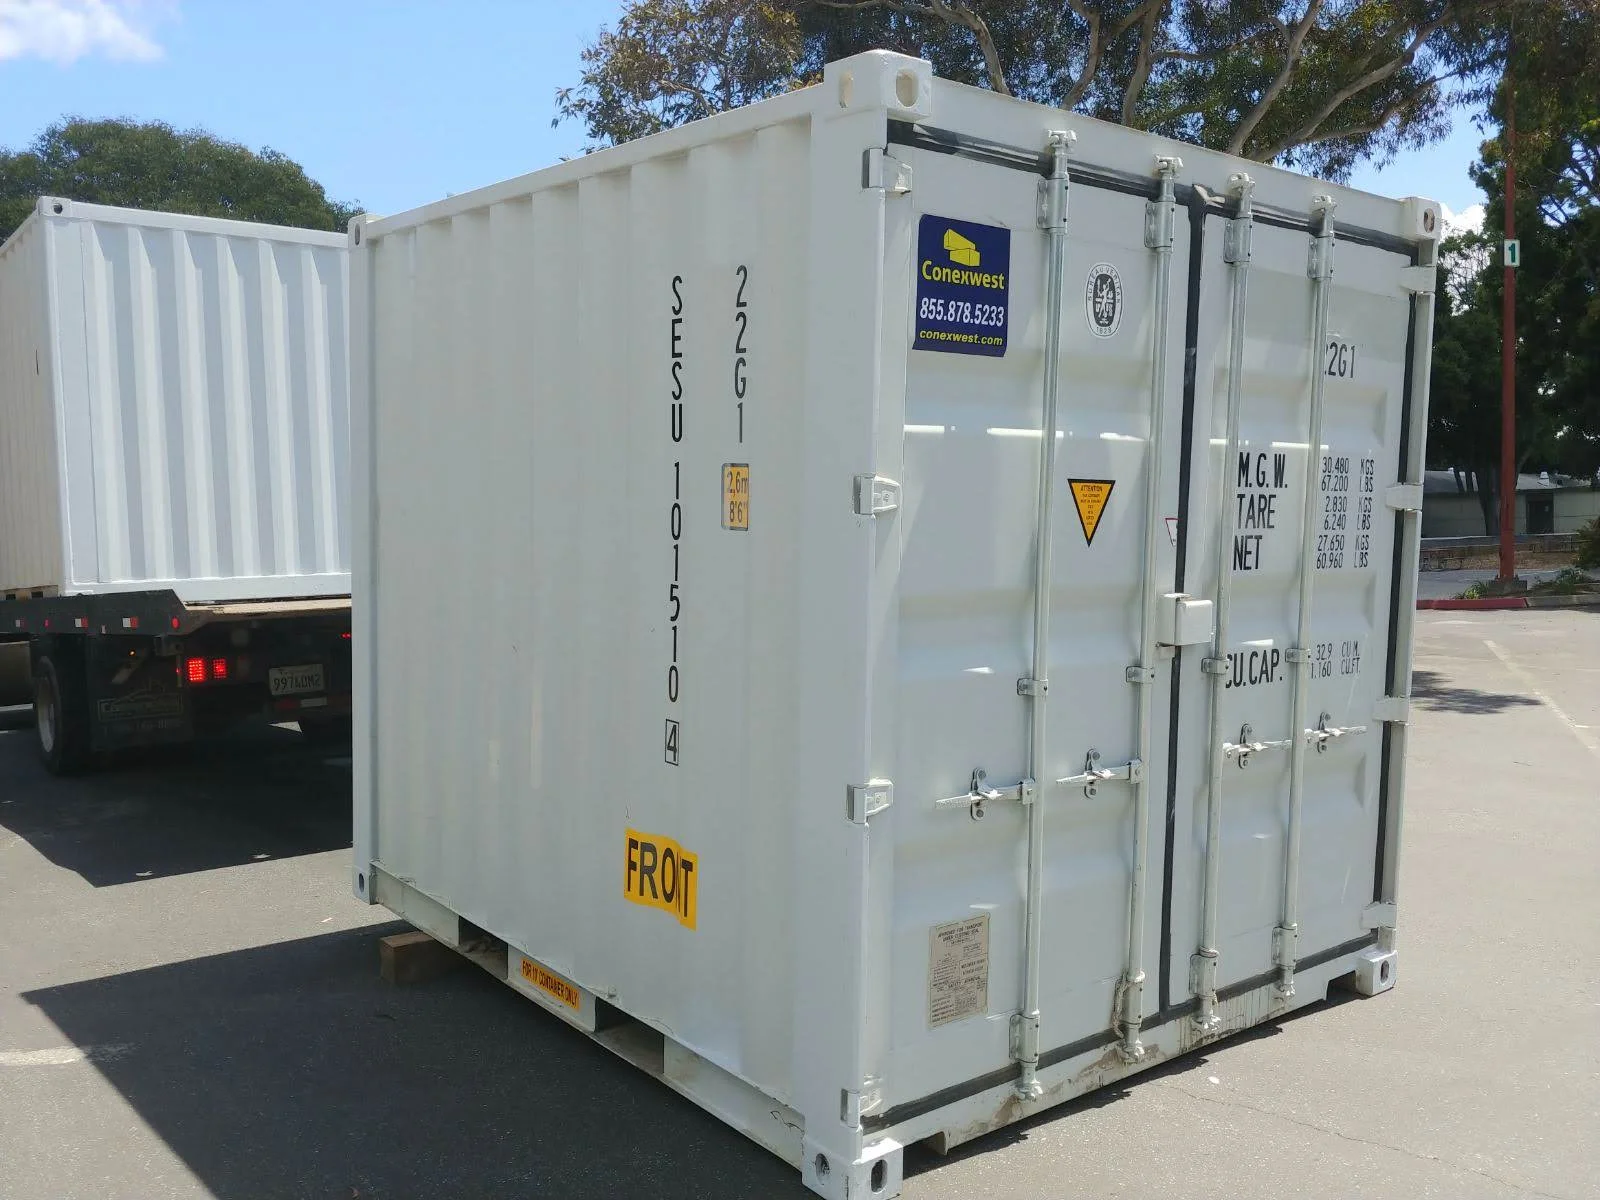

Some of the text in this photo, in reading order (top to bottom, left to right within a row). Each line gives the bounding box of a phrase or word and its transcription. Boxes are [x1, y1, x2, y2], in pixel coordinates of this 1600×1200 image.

[1508, 242, 1516, 263] 1
[921, 260, 1006, 290] Conexwest
[919, 297, 1004, 327] 855.878.5233
[919, 329, 1003, 346] conexwest.com
[734, 265, 748, 444] 22G1
[1322, 457, 1350, 474] 30.480
[1360, 459, 1375, 475] KGS
[1321, 475, 1373, 492] 67.200 LBS
[667, 275, 683, 763] SESU 101510 4
[1236, 494, 1372, 530] TARE 2.830 KGS
[1323, 513, 1371, 531] 6.240 LBS
[1233, 534, 1370, 571] NET 27.650 KGS
[1316, 553, 1368, 569] 60.960 LBS
[522, 960, 532, 978] FOR
